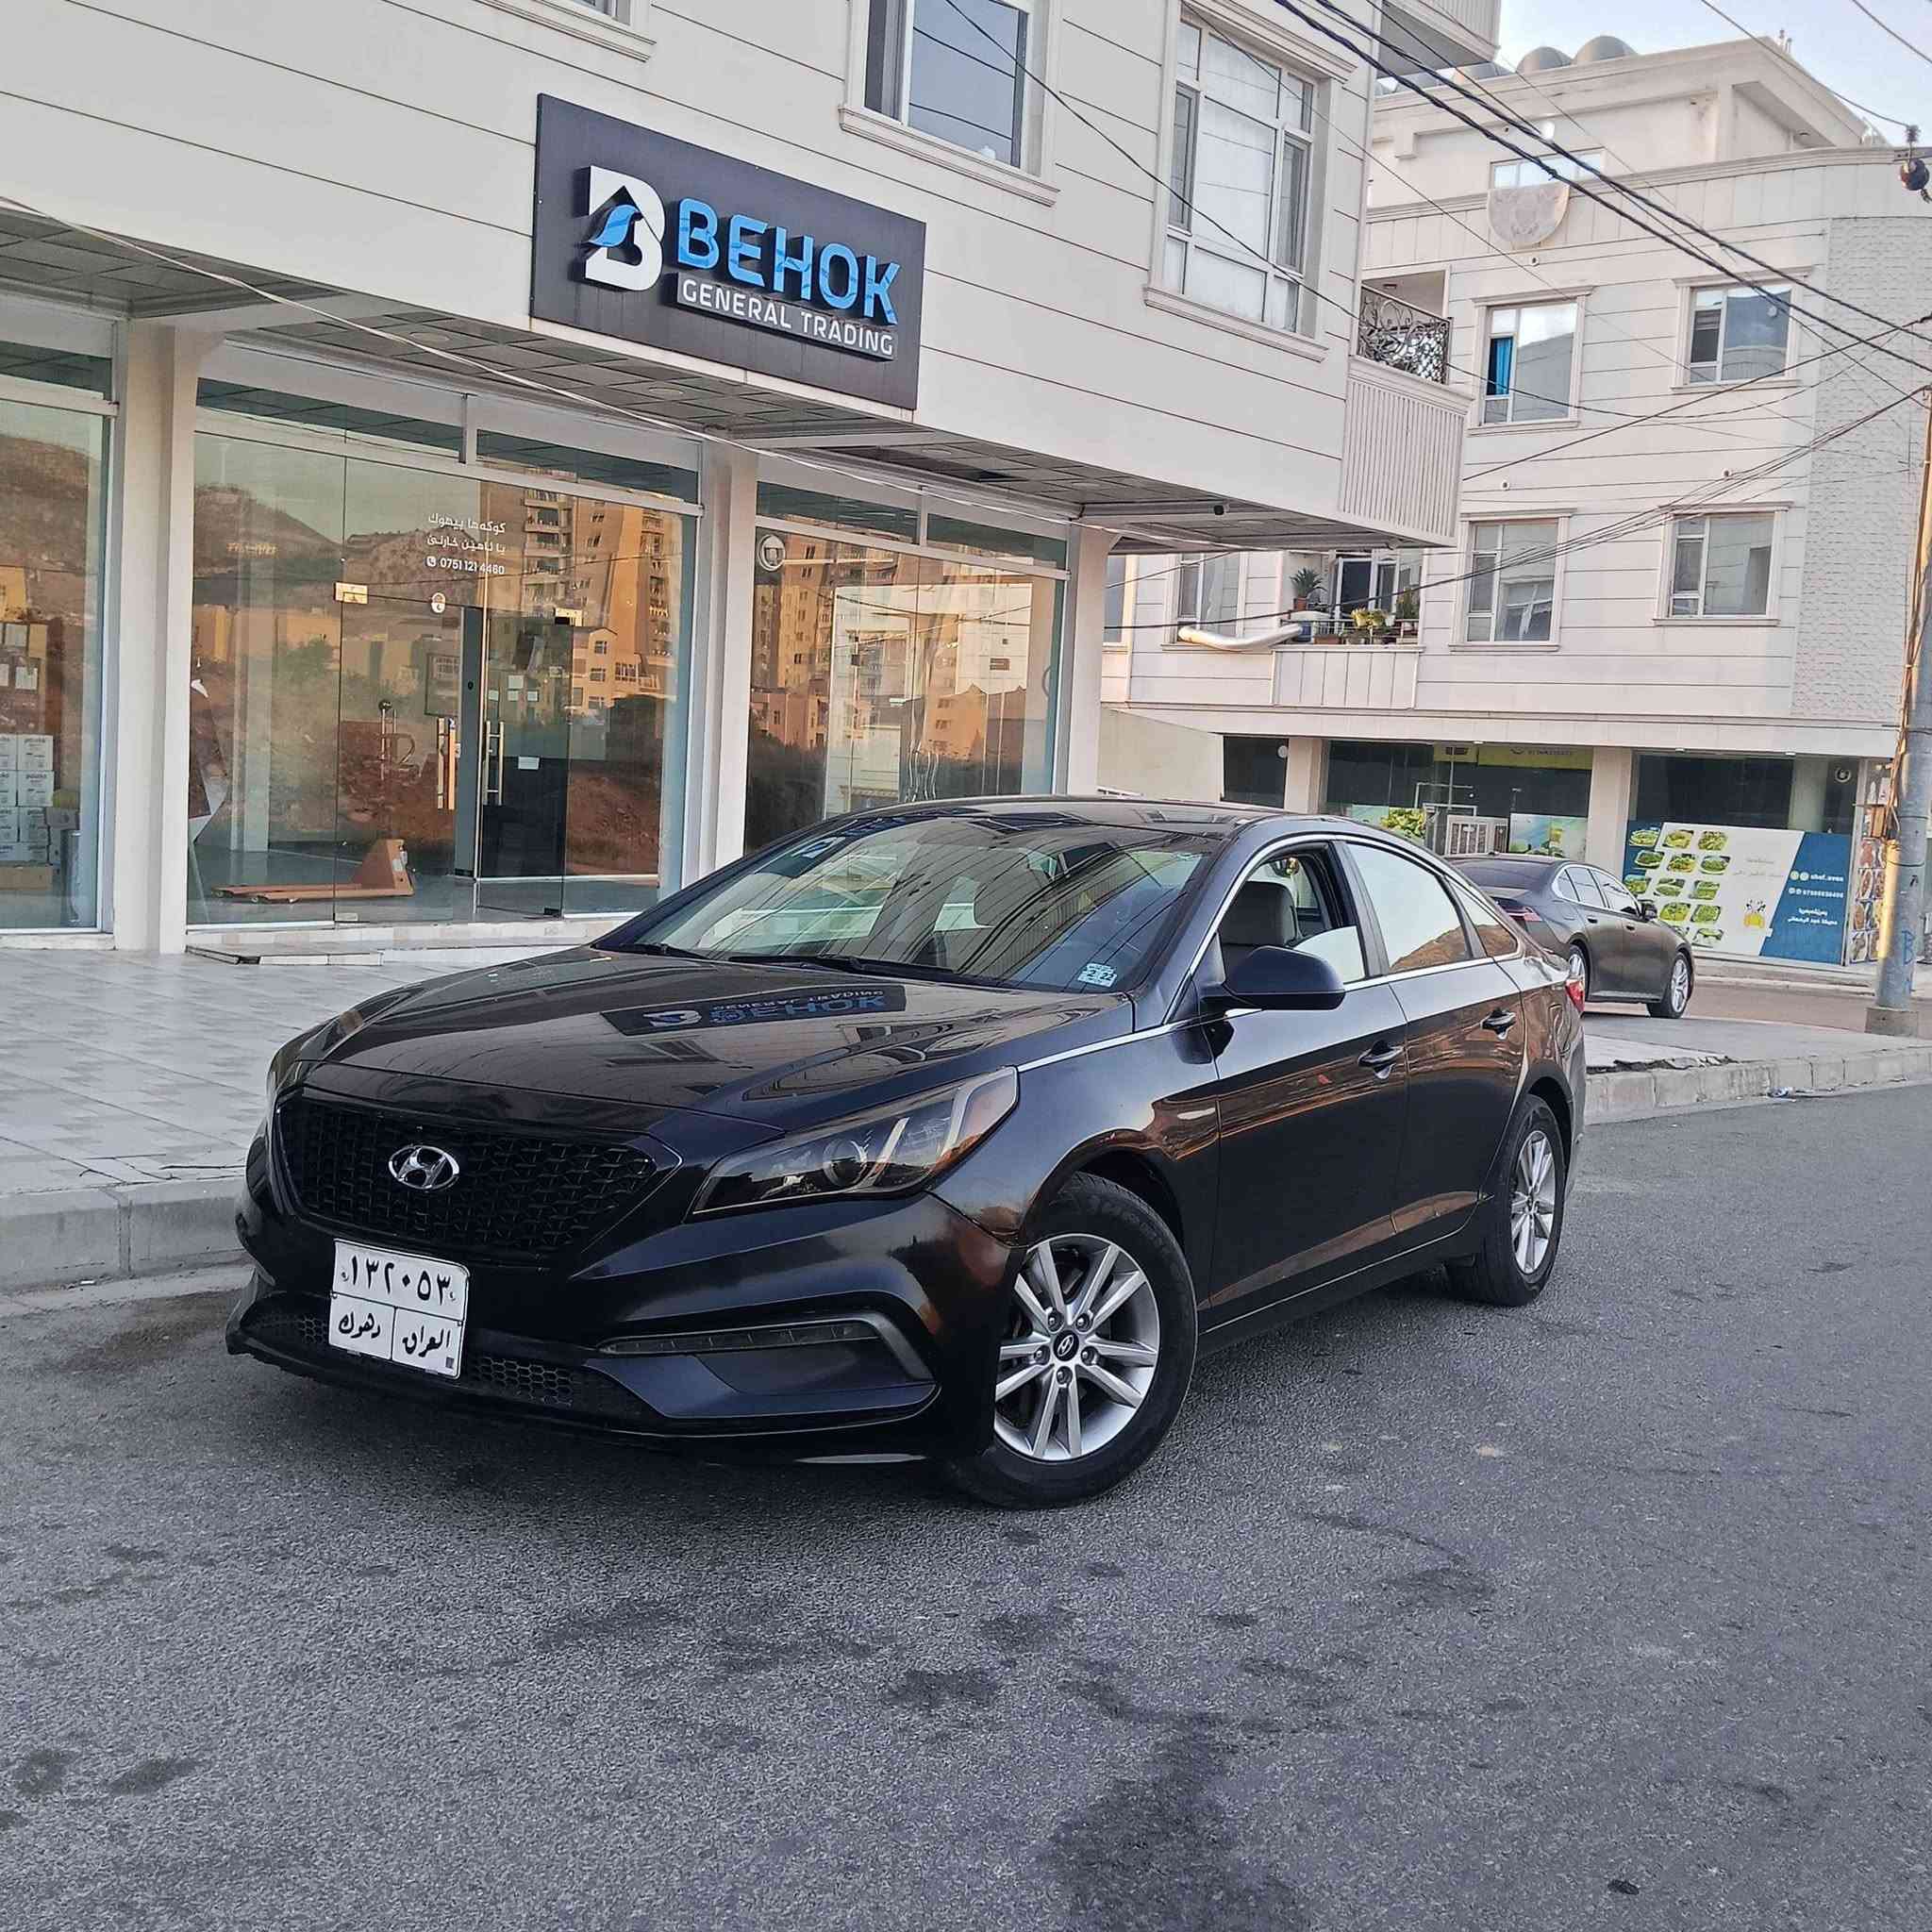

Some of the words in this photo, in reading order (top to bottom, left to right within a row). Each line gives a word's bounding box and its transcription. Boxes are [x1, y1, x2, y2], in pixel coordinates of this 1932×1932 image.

[677, 197, 901, 325] BEHOK
[682, 278, 792, 329] GENERAL
[800, 311, 894, 357] TRADING
[440, 558, 462, 571] 0751
[464, 560, 477, 572] 121
[350, 1255, 451, 1306] ١٣٢٠٥٣
[338, 1311, 381, 1340] دهوك
